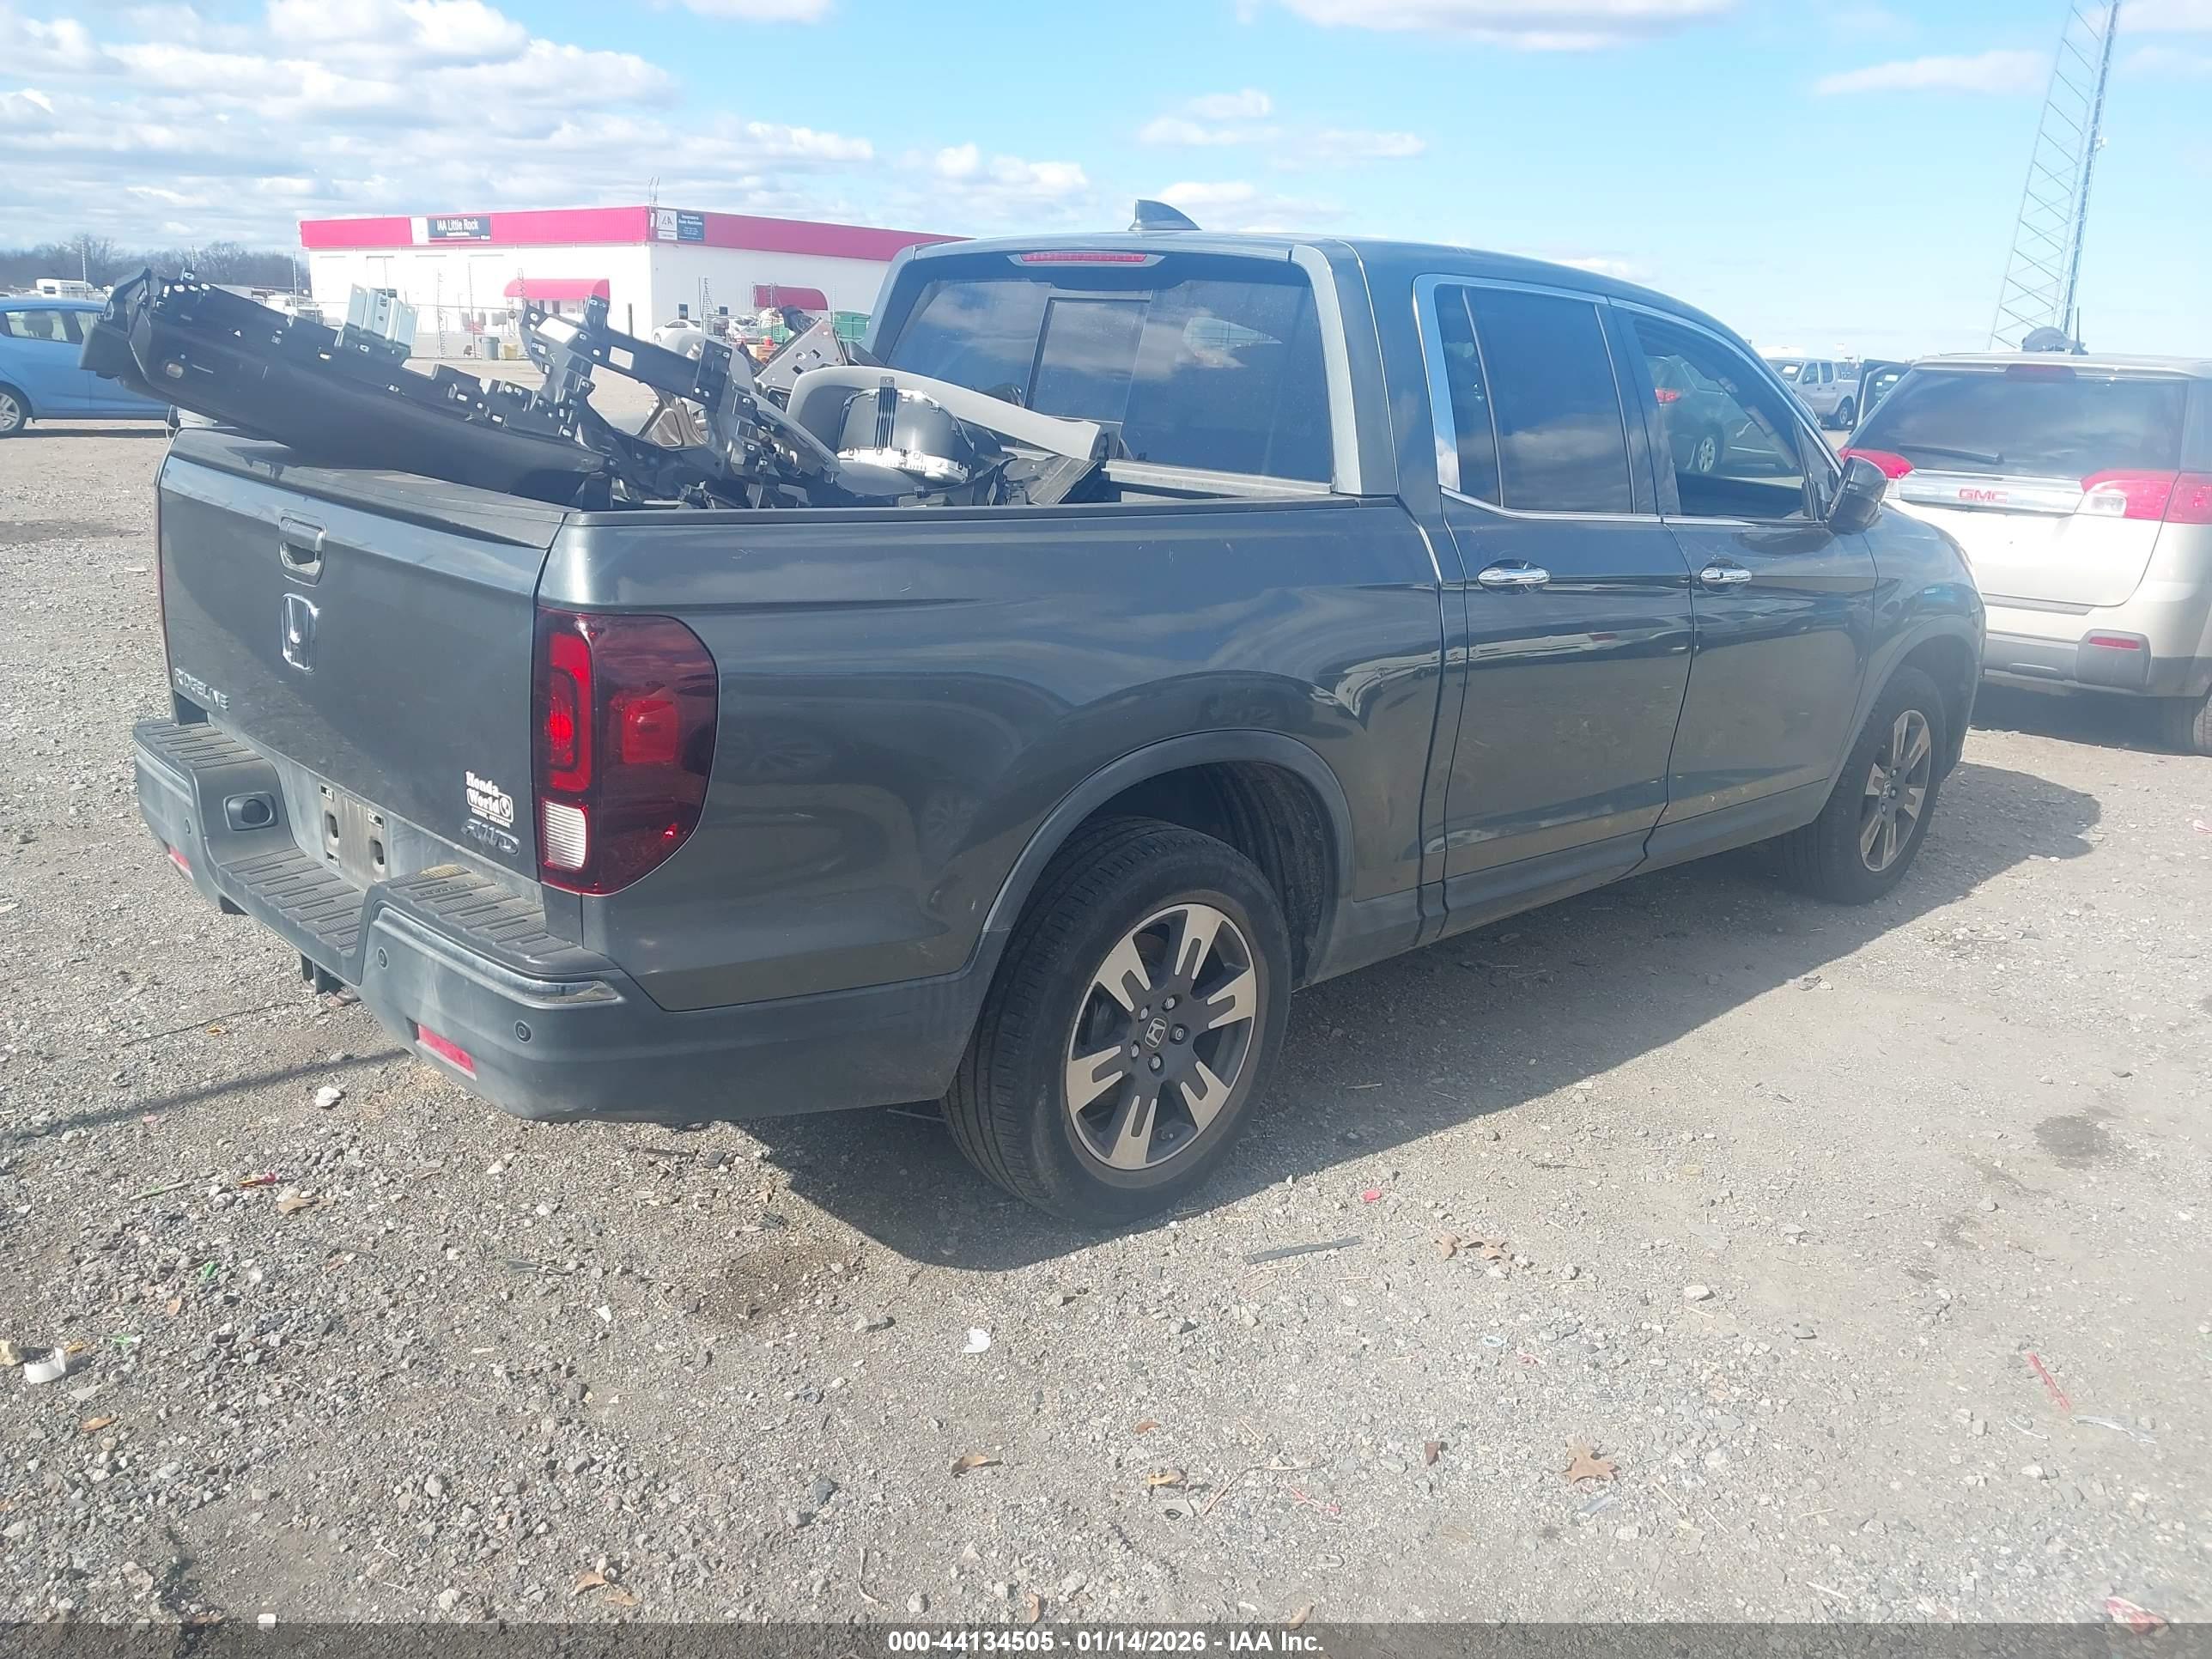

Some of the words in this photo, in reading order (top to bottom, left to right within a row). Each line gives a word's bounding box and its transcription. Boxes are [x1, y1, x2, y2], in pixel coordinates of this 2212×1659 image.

[436, 219, 447, 231] IAA
[447, 219, 463, 231] Little
[464, 218, 479, 230] Rock
[1959, 488, 2008, 504] GMC
[174, 667, 229, 711] RIDGELINE
[465, 771, 500, 799] Honda
[468, 788, 501, 815] World
[461, 817, 520, 857] AWD
